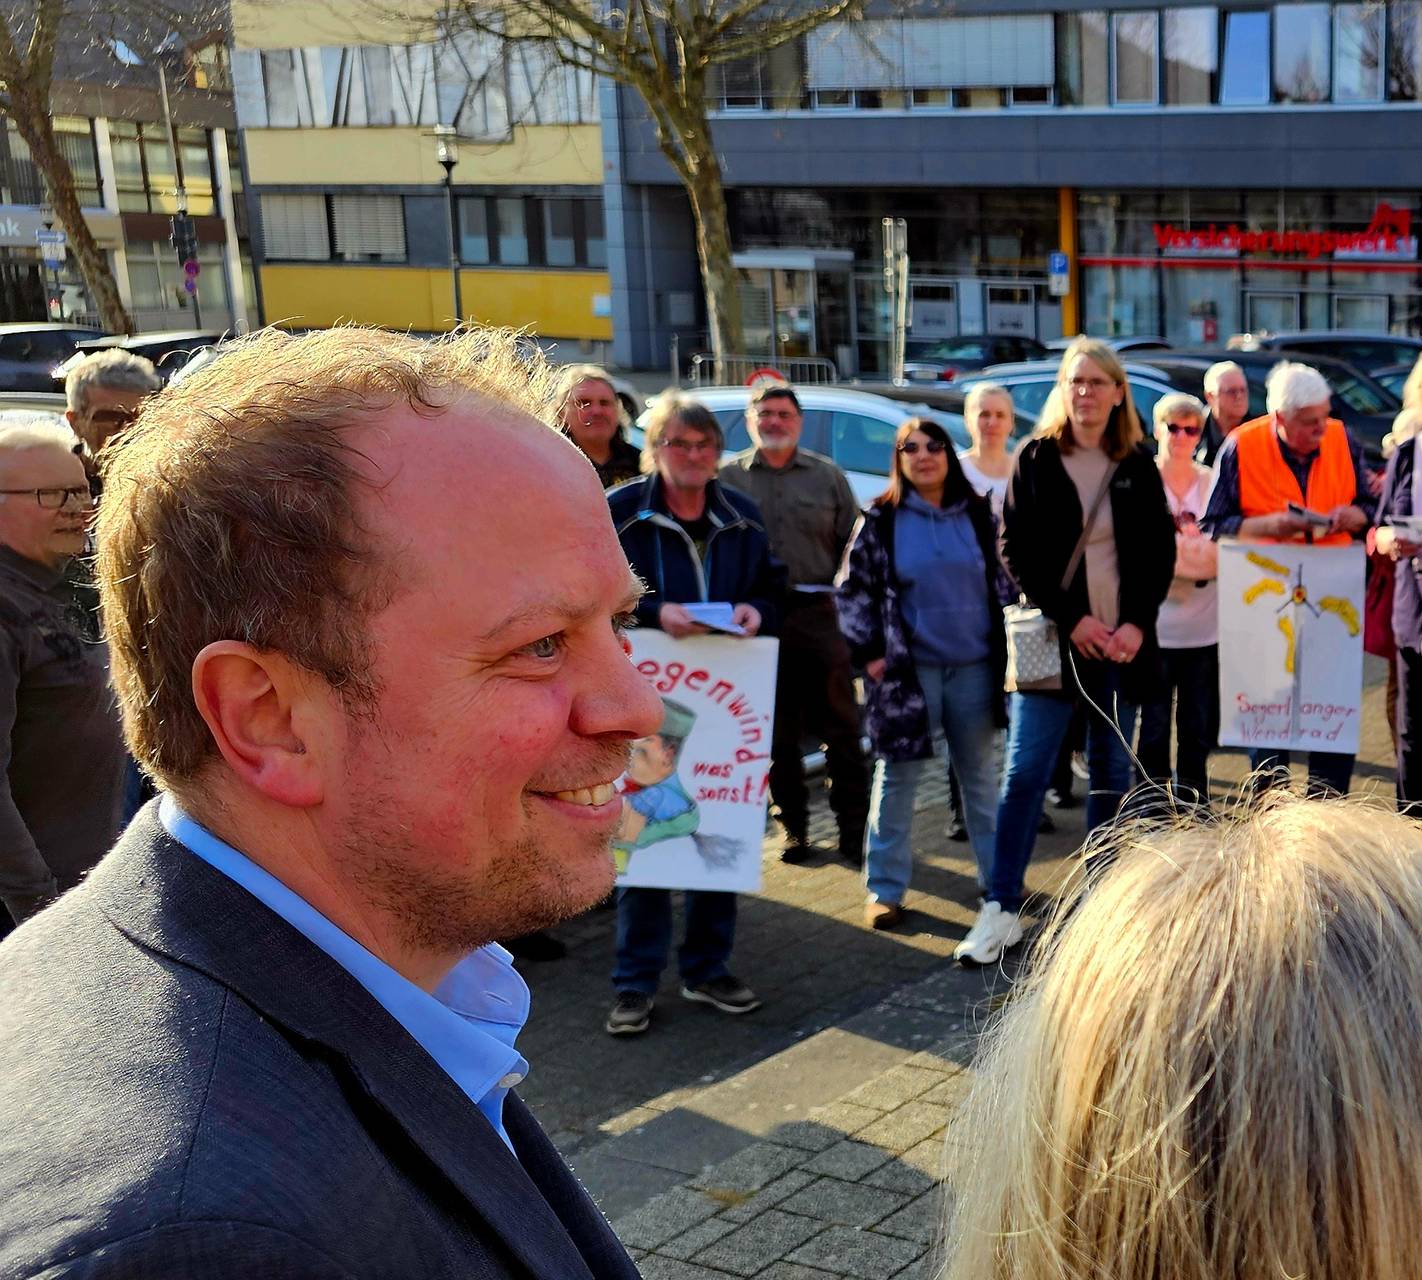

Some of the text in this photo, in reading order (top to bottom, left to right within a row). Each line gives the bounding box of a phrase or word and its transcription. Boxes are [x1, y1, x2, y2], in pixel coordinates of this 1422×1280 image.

[623, 641, 770, 764] egenwind
[692, 762, 733, 780] was
[696, 773, 769, 807] sonst!
